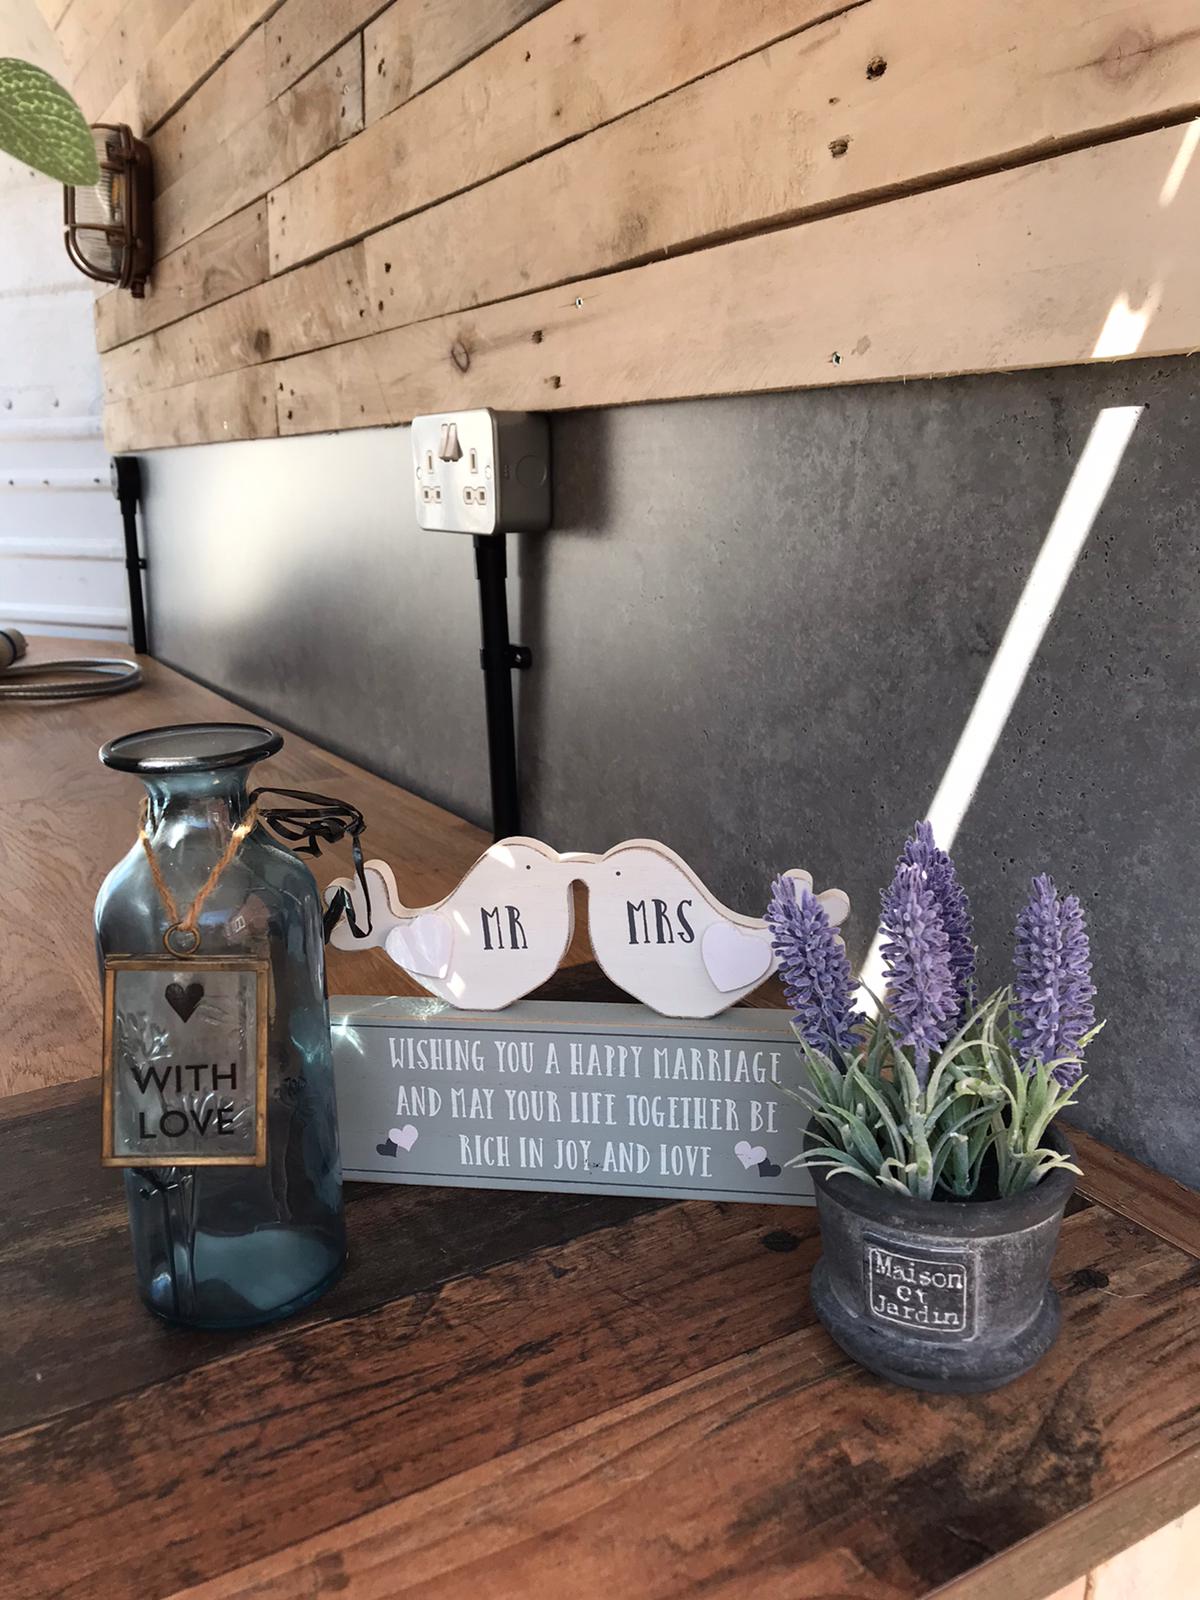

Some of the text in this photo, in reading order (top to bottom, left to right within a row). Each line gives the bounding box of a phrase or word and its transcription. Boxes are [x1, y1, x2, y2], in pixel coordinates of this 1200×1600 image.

[481, 906, 528, 950] MR
[627, 898, 695, 944] MRS
[131, 1063, 236, 1094] WITH
[389, 1037, 782, 1083] WISHING YOU A HAPPY MARRIAGE
[140, 1108, 234, 1139] LOVE
[396, 1087, 778, 1133] AND MAY YOUR LIFE TOGETHER BE
[459, 1135, 712, 1177] RICH IN JOY AND LOVE
[875, 1252, 963, 1289] Maison
[874, 1295, 959, 1325] Jardin
